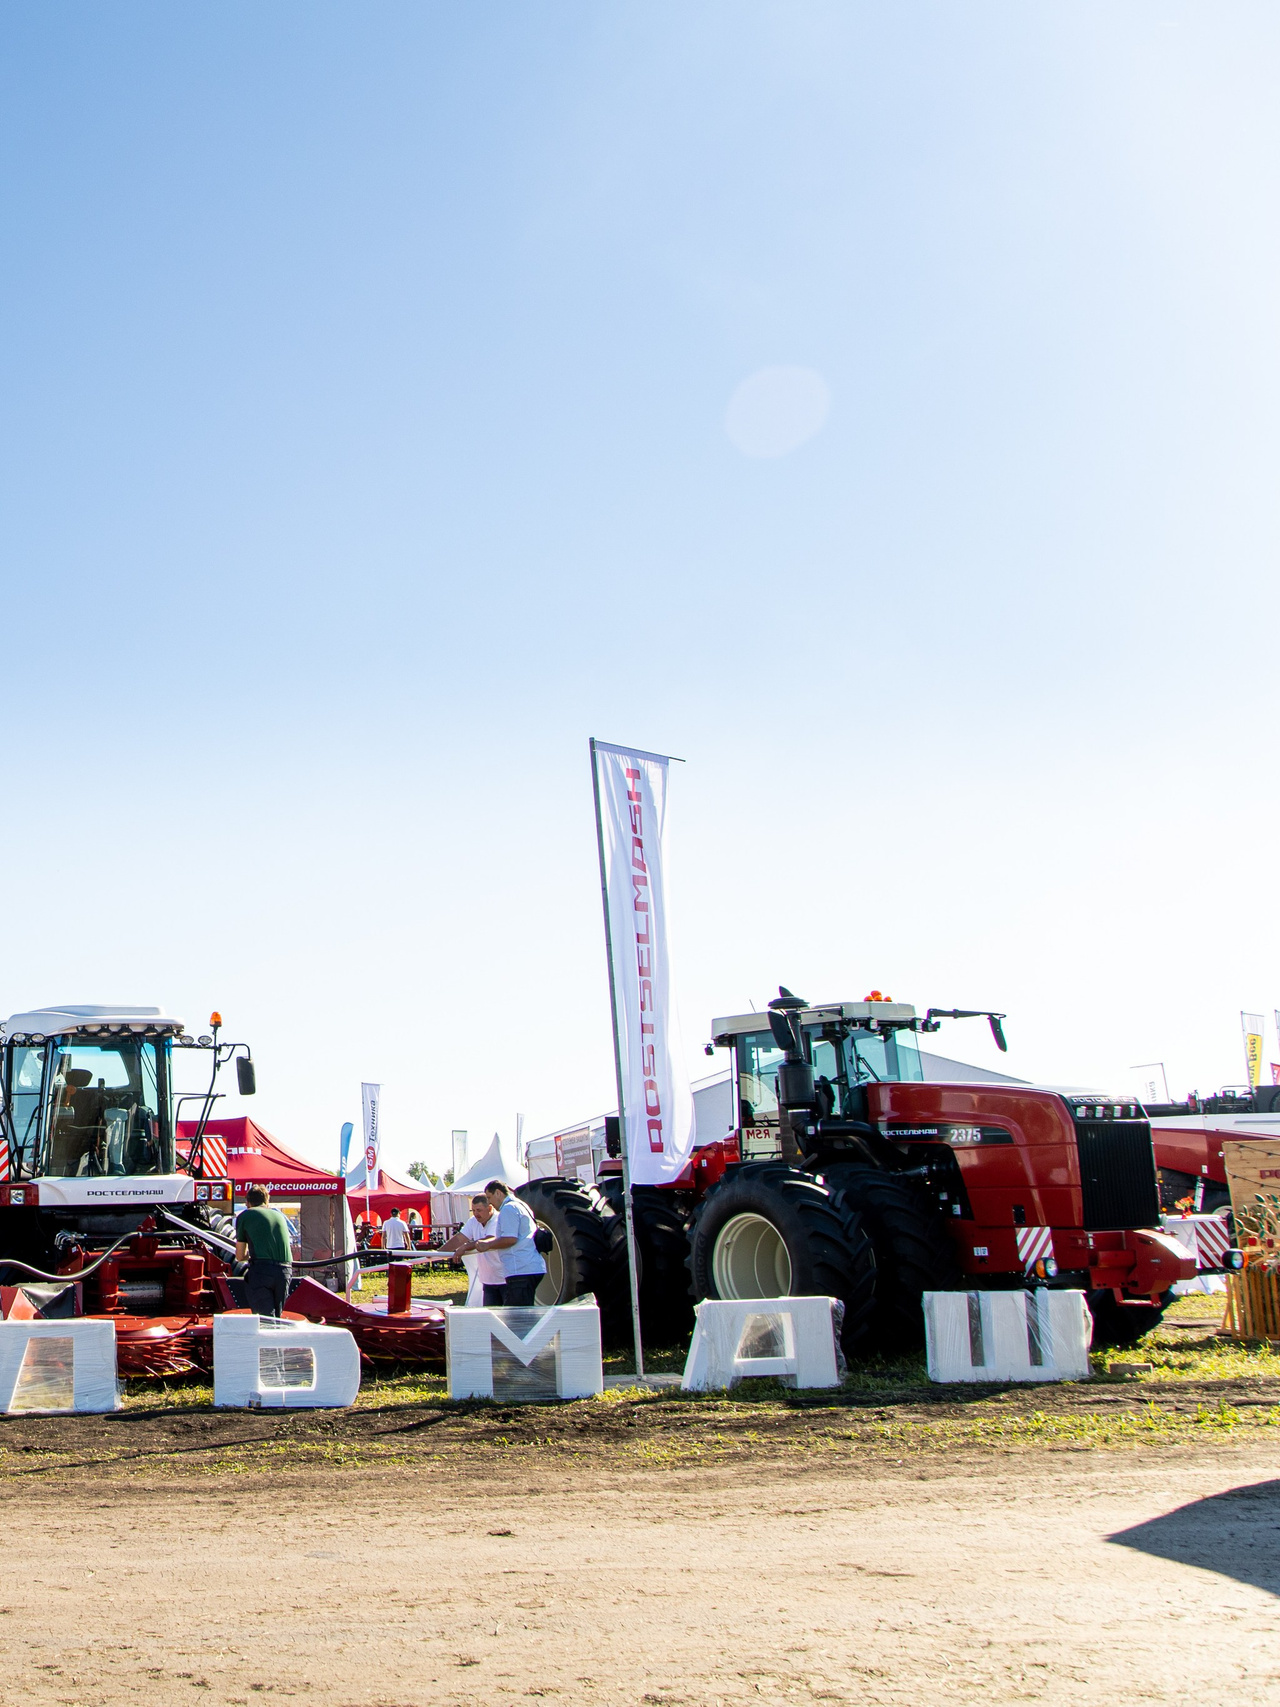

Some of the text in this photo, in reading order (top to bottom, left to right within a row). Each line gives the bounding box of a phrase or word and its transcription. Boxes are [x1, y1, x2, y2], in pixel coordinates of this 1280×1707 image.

[626, 768, 664, 1153] ROSTSELMASH
[368, 1100, 377, 1143] Техника
[950, 1128, 981, 1143] 2375
[87, 1189, 164, 1197] РОСТСЕЛЬМАШ
